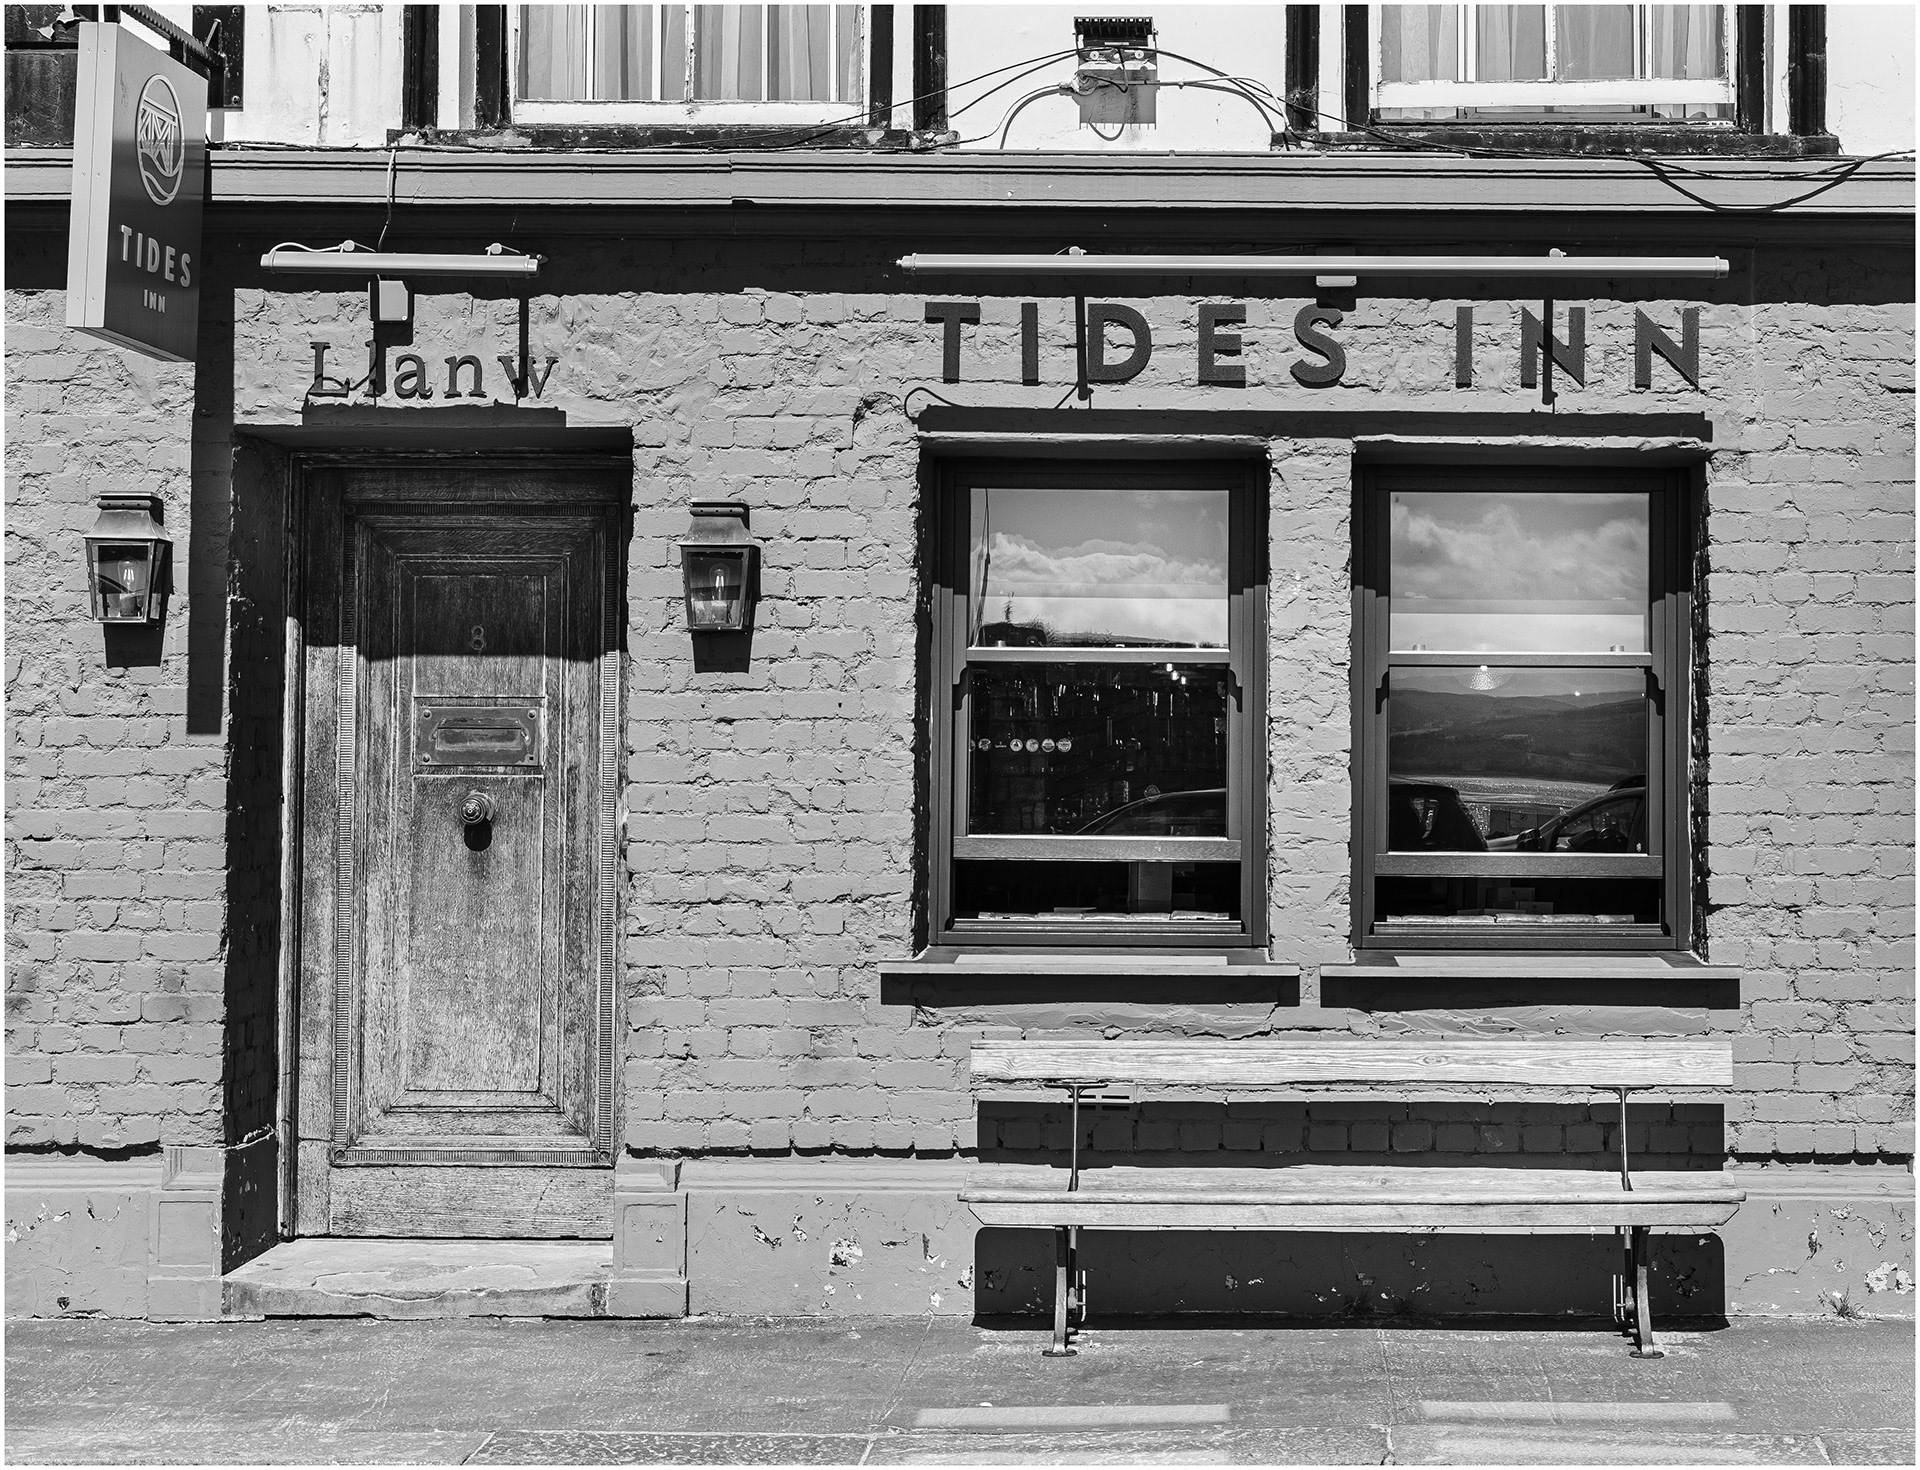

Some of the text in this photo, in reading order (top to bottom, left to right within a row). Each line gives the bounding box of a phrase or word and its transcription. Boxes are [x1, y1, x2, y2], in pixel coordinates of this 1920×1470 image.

[121, 224, 191, 287] TIDES
[144, 289, 166, 313] INN
[308, 341, 560, 398] Llanw
[925, 302, 1700, 391] TIDES INN
